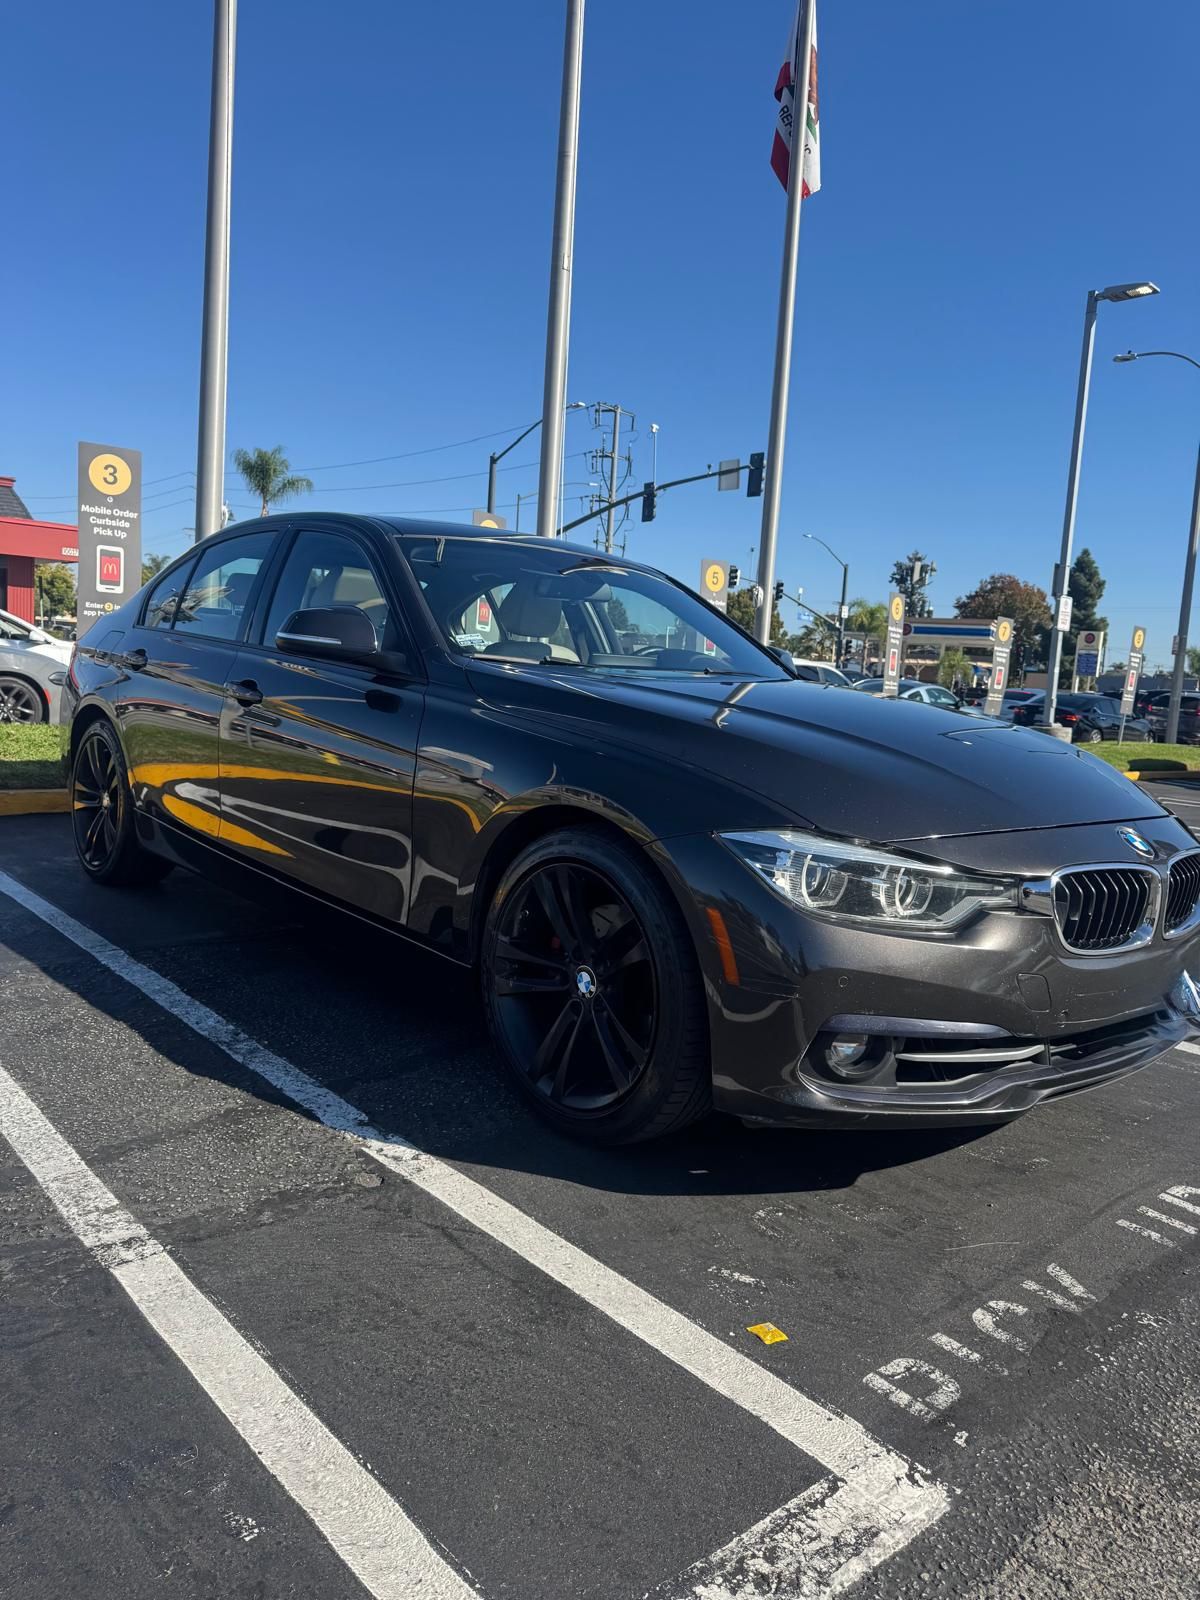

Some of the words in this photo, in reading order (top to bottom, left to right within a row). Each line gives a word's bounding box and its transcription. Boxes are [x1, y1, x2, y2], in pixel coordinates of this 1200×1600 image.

[102, 464, 118, 485] 3
[81, 504, 112, 515] Mobile
[112, 508, 138, 519] Order
[89, 516, 130, 528] Curbside
[93, 526, 113, 536] Pick
[114, 529, 127, 539] Up
[712, 571, 719, 585] 5
[85, 601, 104, 609] Enter
[895, 602, 900, 615] 6
[1002, 626, 1007, 638] 7
